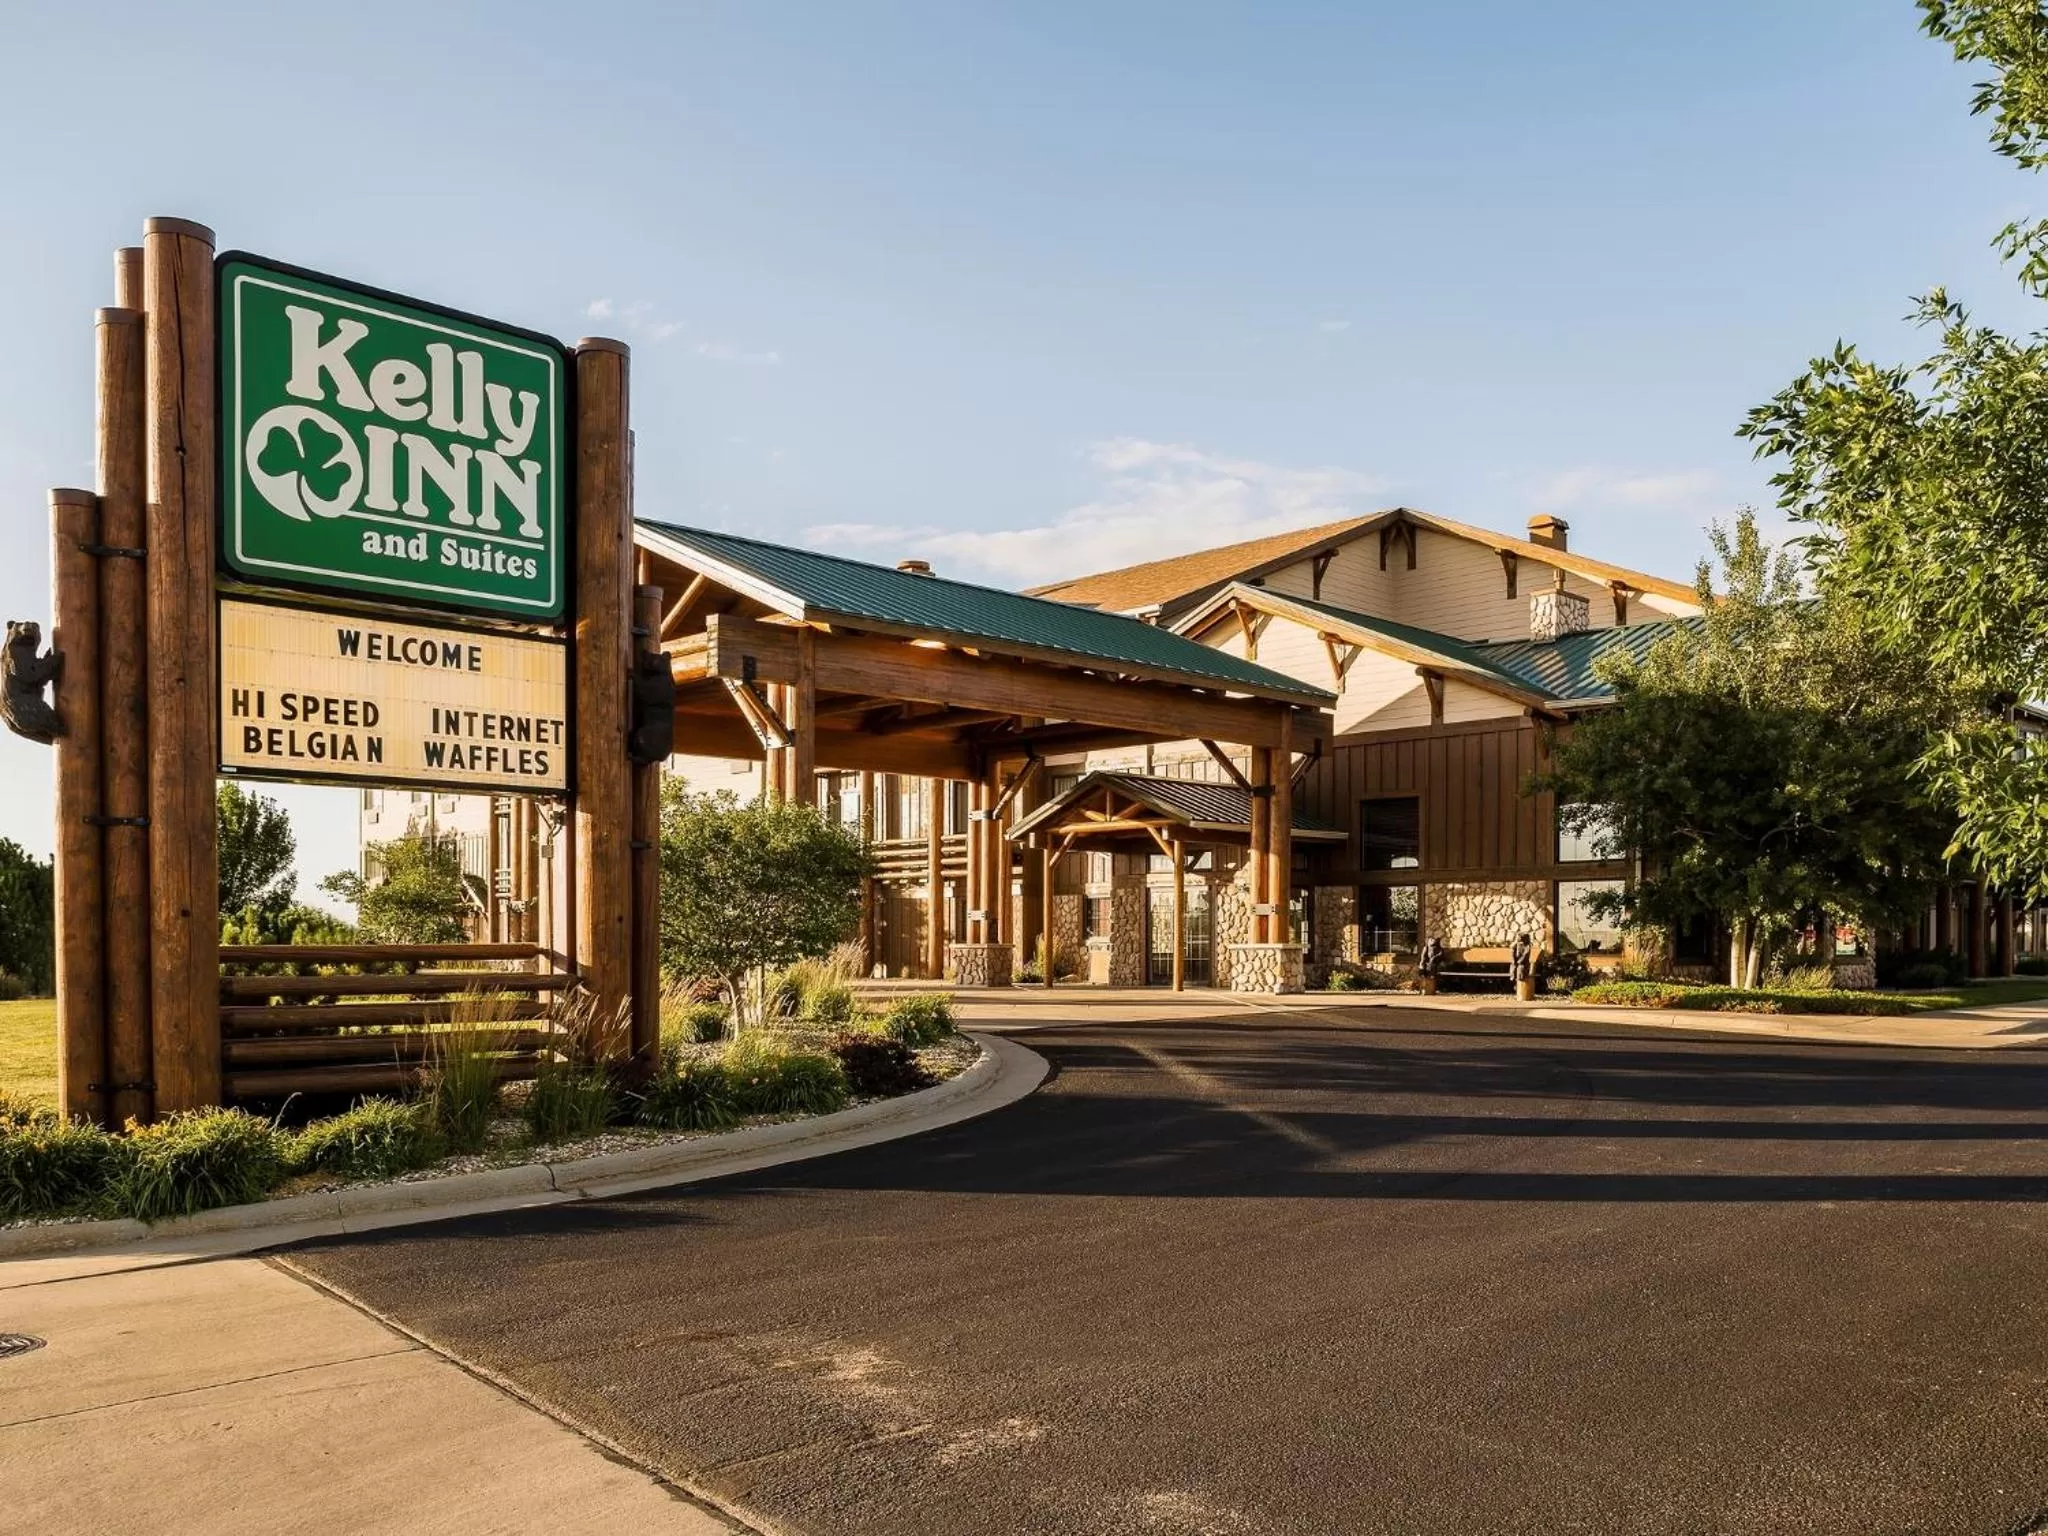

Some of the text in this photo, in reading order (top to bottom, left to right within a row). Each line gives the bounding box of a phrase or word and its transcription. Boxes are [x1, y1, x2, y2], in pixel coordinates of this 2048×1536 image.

[285, 305, 540, 456] Kelly
[364, 425, 543, 538] INN
[362, 531, 538, 579] and Suites
[338, 629, 482, 672] WELCOME
[231, 688, 564, 745] HI SPEED INTERNET
[243, 726, 549, 776] BELGIAN WAFFLES
